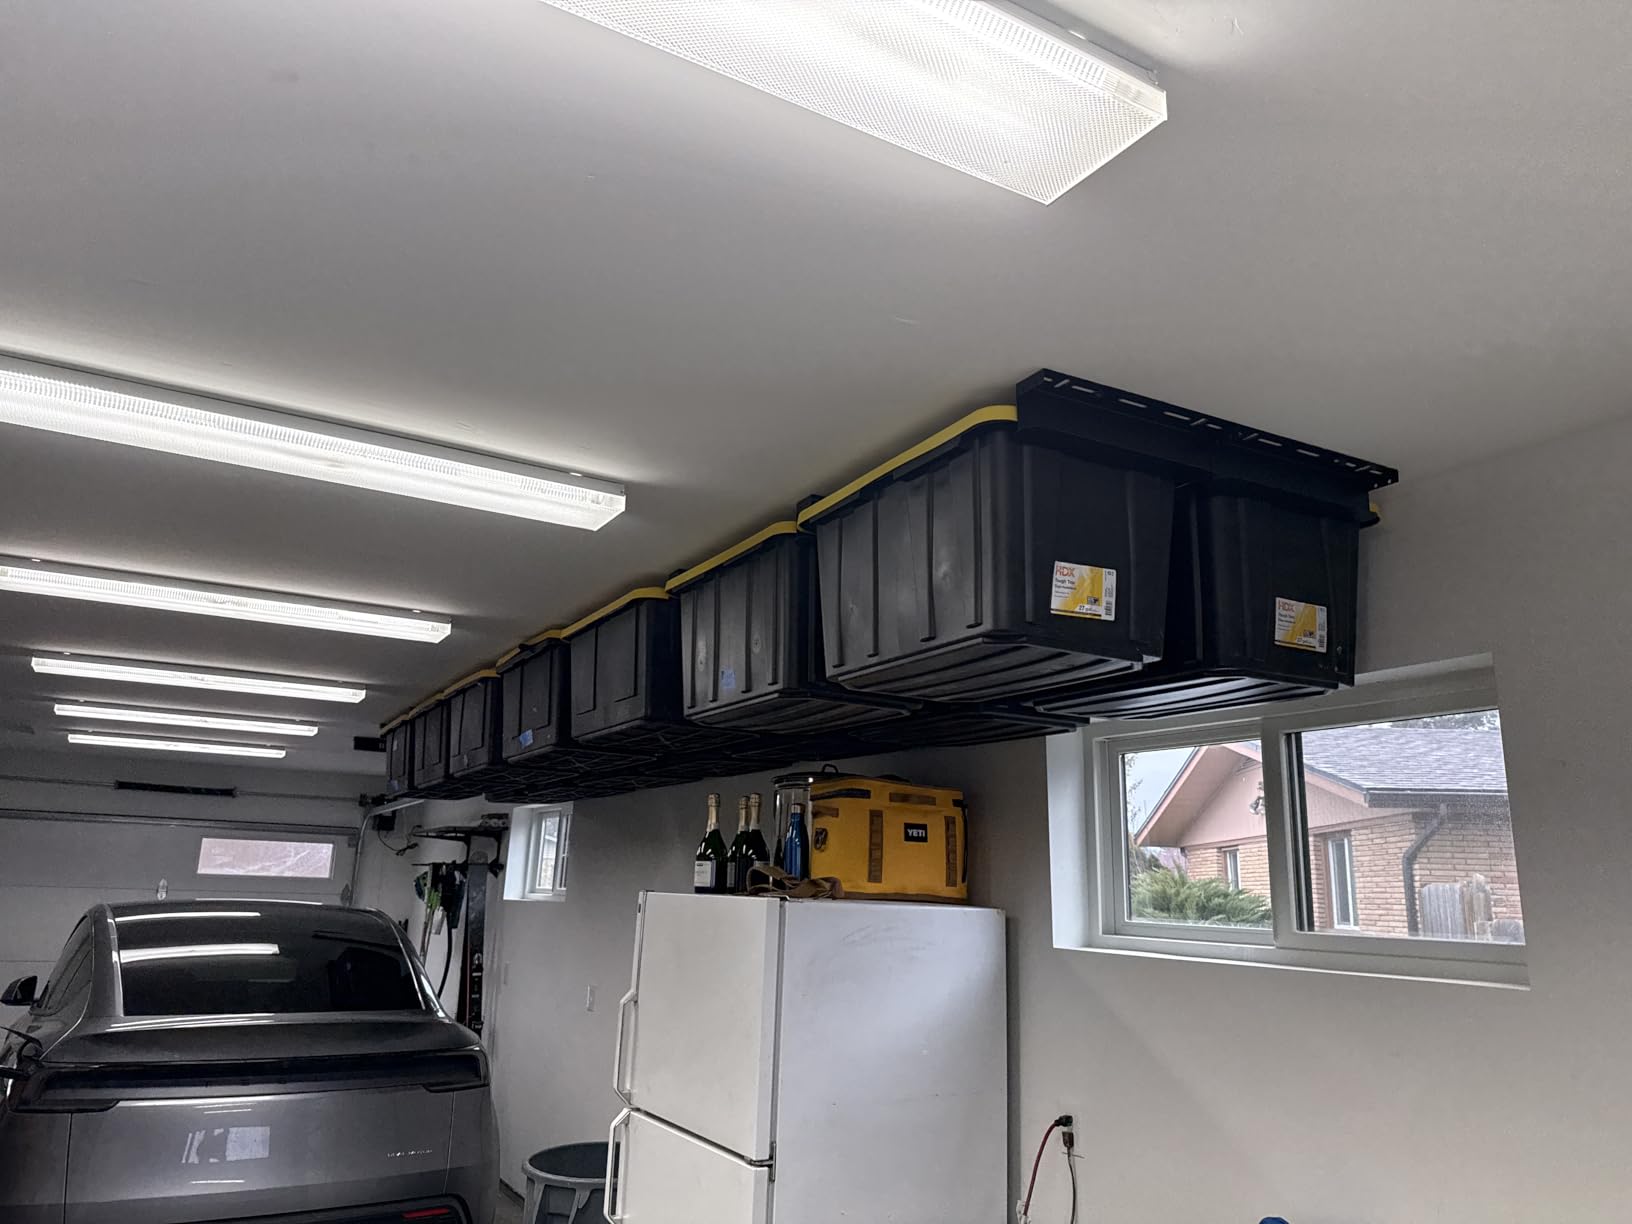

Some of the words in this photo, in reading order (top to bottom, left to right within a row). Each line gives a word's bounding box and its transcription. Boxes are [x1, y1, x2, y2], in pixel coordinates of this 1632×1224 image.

[1056, 565, 1075, 577] HDX
[1278, 600, 1296, 612] HDX
[907, 828, 926, 837] YETI
